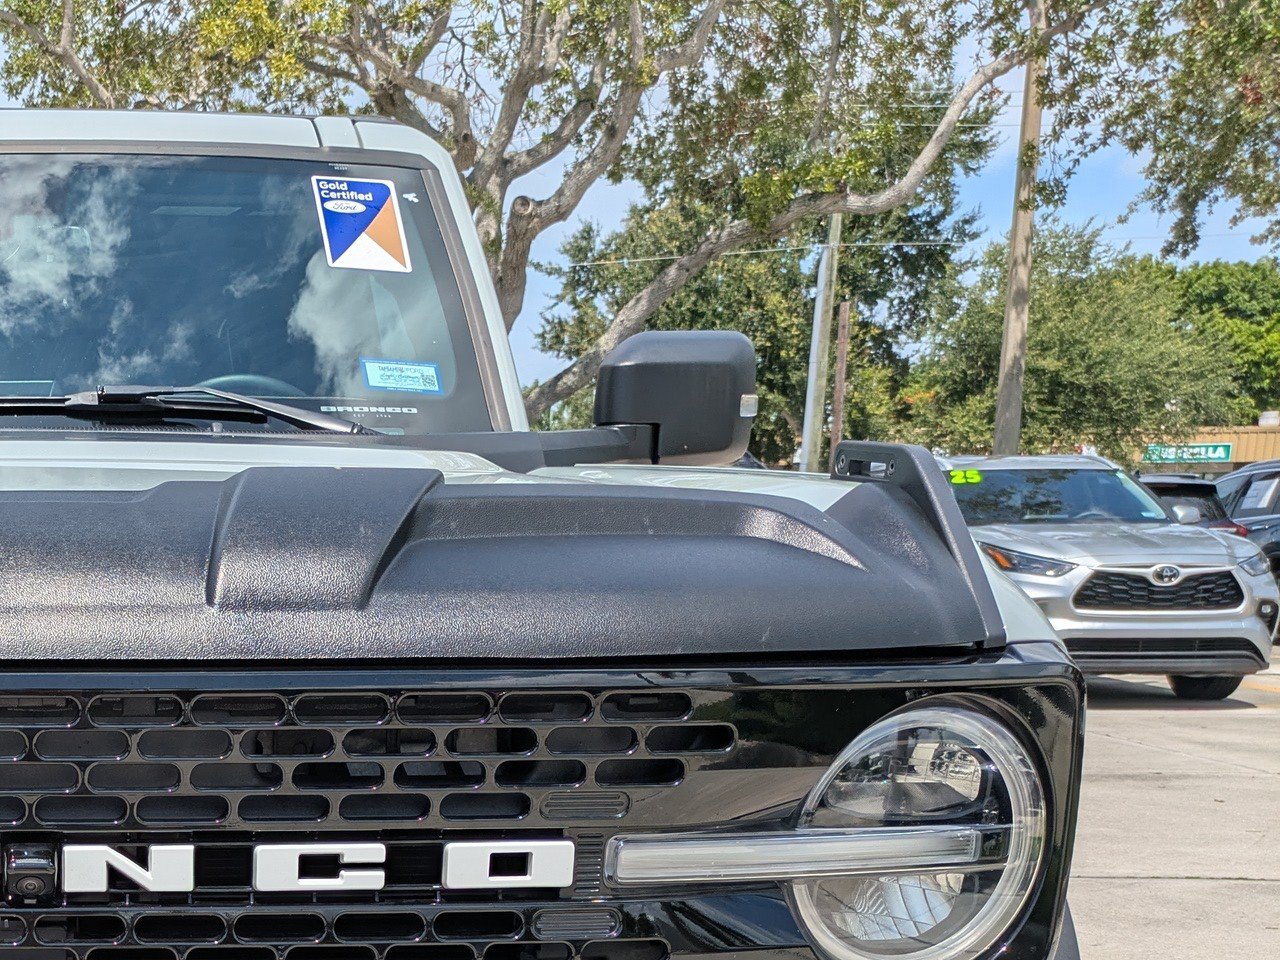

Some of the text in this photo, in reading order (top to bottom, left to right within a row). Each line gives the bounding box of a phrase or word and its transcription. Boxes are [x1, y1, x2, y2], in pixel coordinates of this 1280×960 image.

[319, 181, 348, 190] Gold
[321, 190, 373, 201] Certified
[332, 202, 357, 211] Ford
[320, 406, 418, 414] BRONCO
[949, 468, 982, 484] 25
